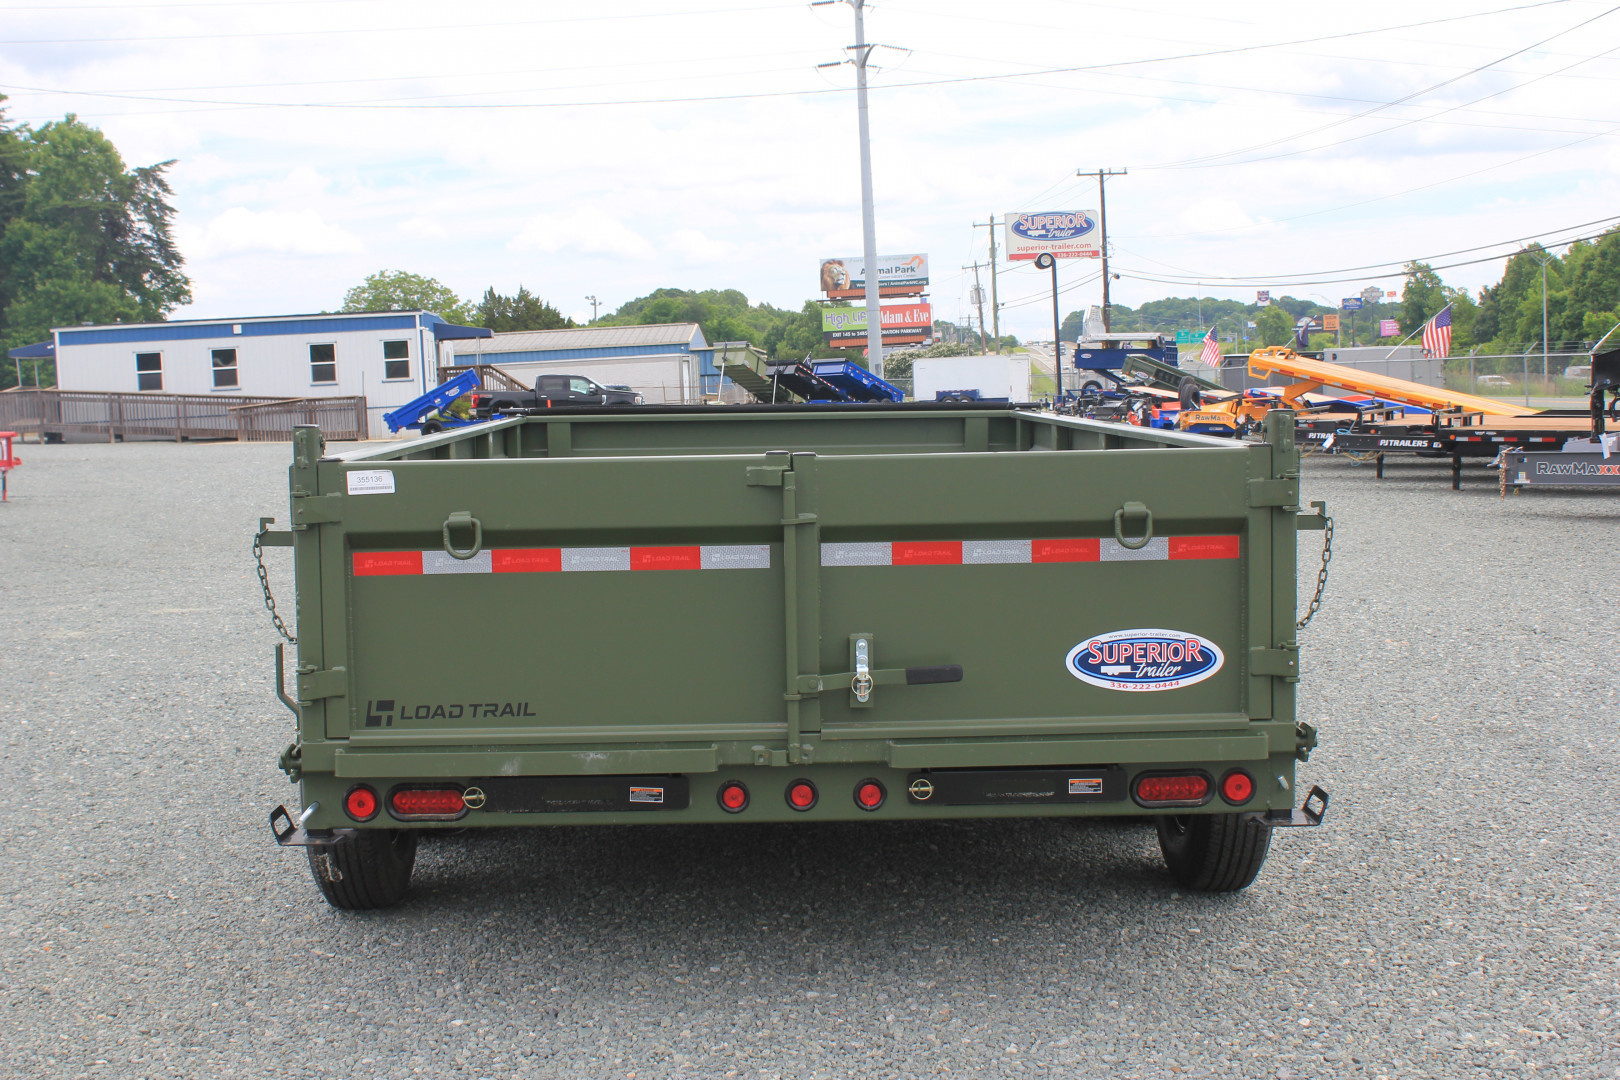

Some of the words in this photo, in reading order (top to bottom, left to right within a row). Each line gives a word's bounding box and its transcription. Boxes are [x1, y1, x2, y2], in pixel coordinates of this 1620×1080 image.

[1020, 212, 1087, 230] SUPERIOR
[1048, 226, 1075, 238] trailer
[1016, 242, 1092, 252] superior-trailer.com
[894, 265, 916, 274] Park
[825, 312, 852, 329] High
[852, 311, 867, 322] Lif
[880, 310, 903, 324] Adam
[904, 310, 913, 324] &
[913, 309, 929, 323] Eve
[356, 475, 383, 484] 355136
[1108, 631, 1181, 639] www.superior-trailer.com
[1087, 637, 1204, 665] SUPERIOR
[1136, 661, 1181, 679] trailer
[1110, 680, 1180, 690] 336-222-0444
[401, 704, 464, 720] LOAD
[468, 702, 537, 718] TRAIL
